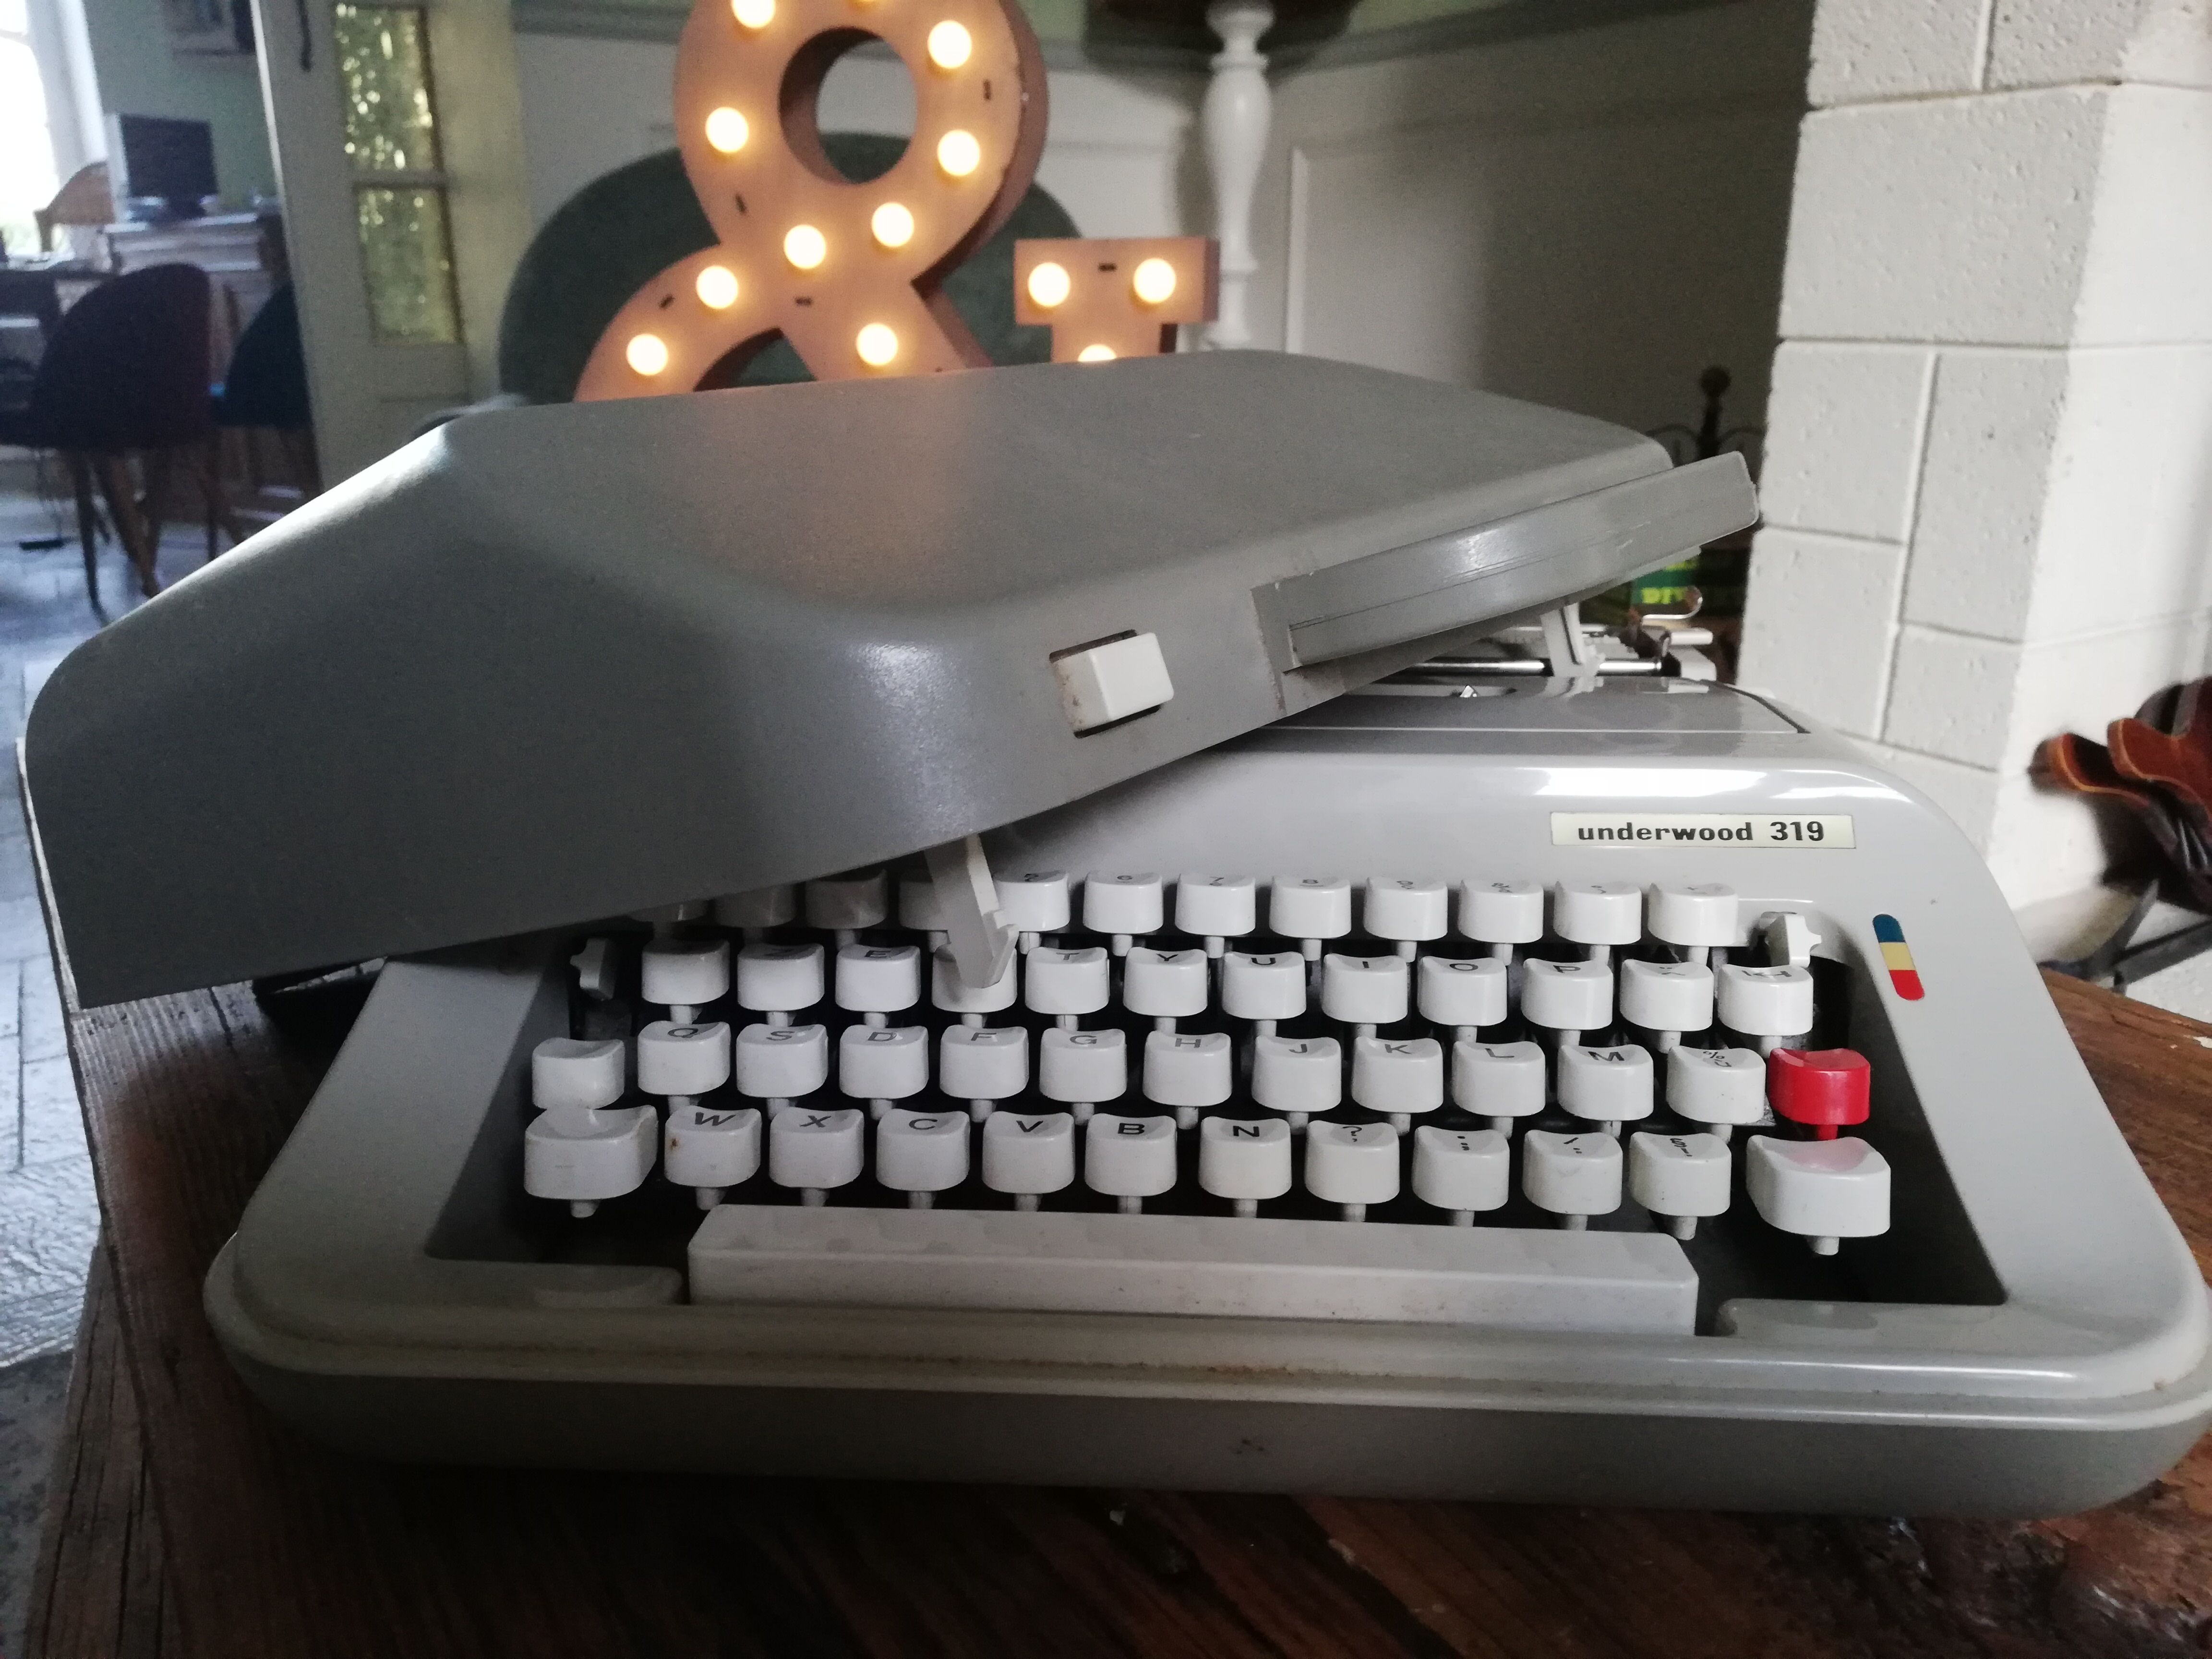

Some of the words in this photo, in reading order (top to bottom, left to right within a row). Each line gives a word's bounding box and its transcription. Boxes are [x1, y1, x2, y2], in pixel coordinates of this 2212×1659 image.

[1578, 822, 1754, 841] underwood
[1769, 821, 1825, 842] 319
[864, 950, 891, 959] E
[1056, 952, 1080, 961] T
[1156, 953, 1178, 962] Y
[1251, 957, 1277, 965] U
[1449, 962, 1479, 971] O
[1553, 965, 1581, 974] P
[667, 1027, 699, 1039] Q
[766, 1030, 796, 1041] S
[867, 1031, 898, 1042] D
[970, 1032, 998, 1042] F
[1069, 1034, 1097, 1045] G
[1174, 1037, 1202, 1048] H
[1288, 1043, 1308, 1054] J
[1384, 1043, 1412, 1055] K
[1485, 1047, 1515, 1058] L
[1587, 1050, 1625, 1062] M
[694, 1111, 737, 1126] W
[799, 1114, 832, 1128] X
[908, 1118, 939, 1130] C
[1015, 1119, 1044, 1133] V
[1117, 1122, 1145, 1135] B
[1232, 1125, 1260, 1138] N
